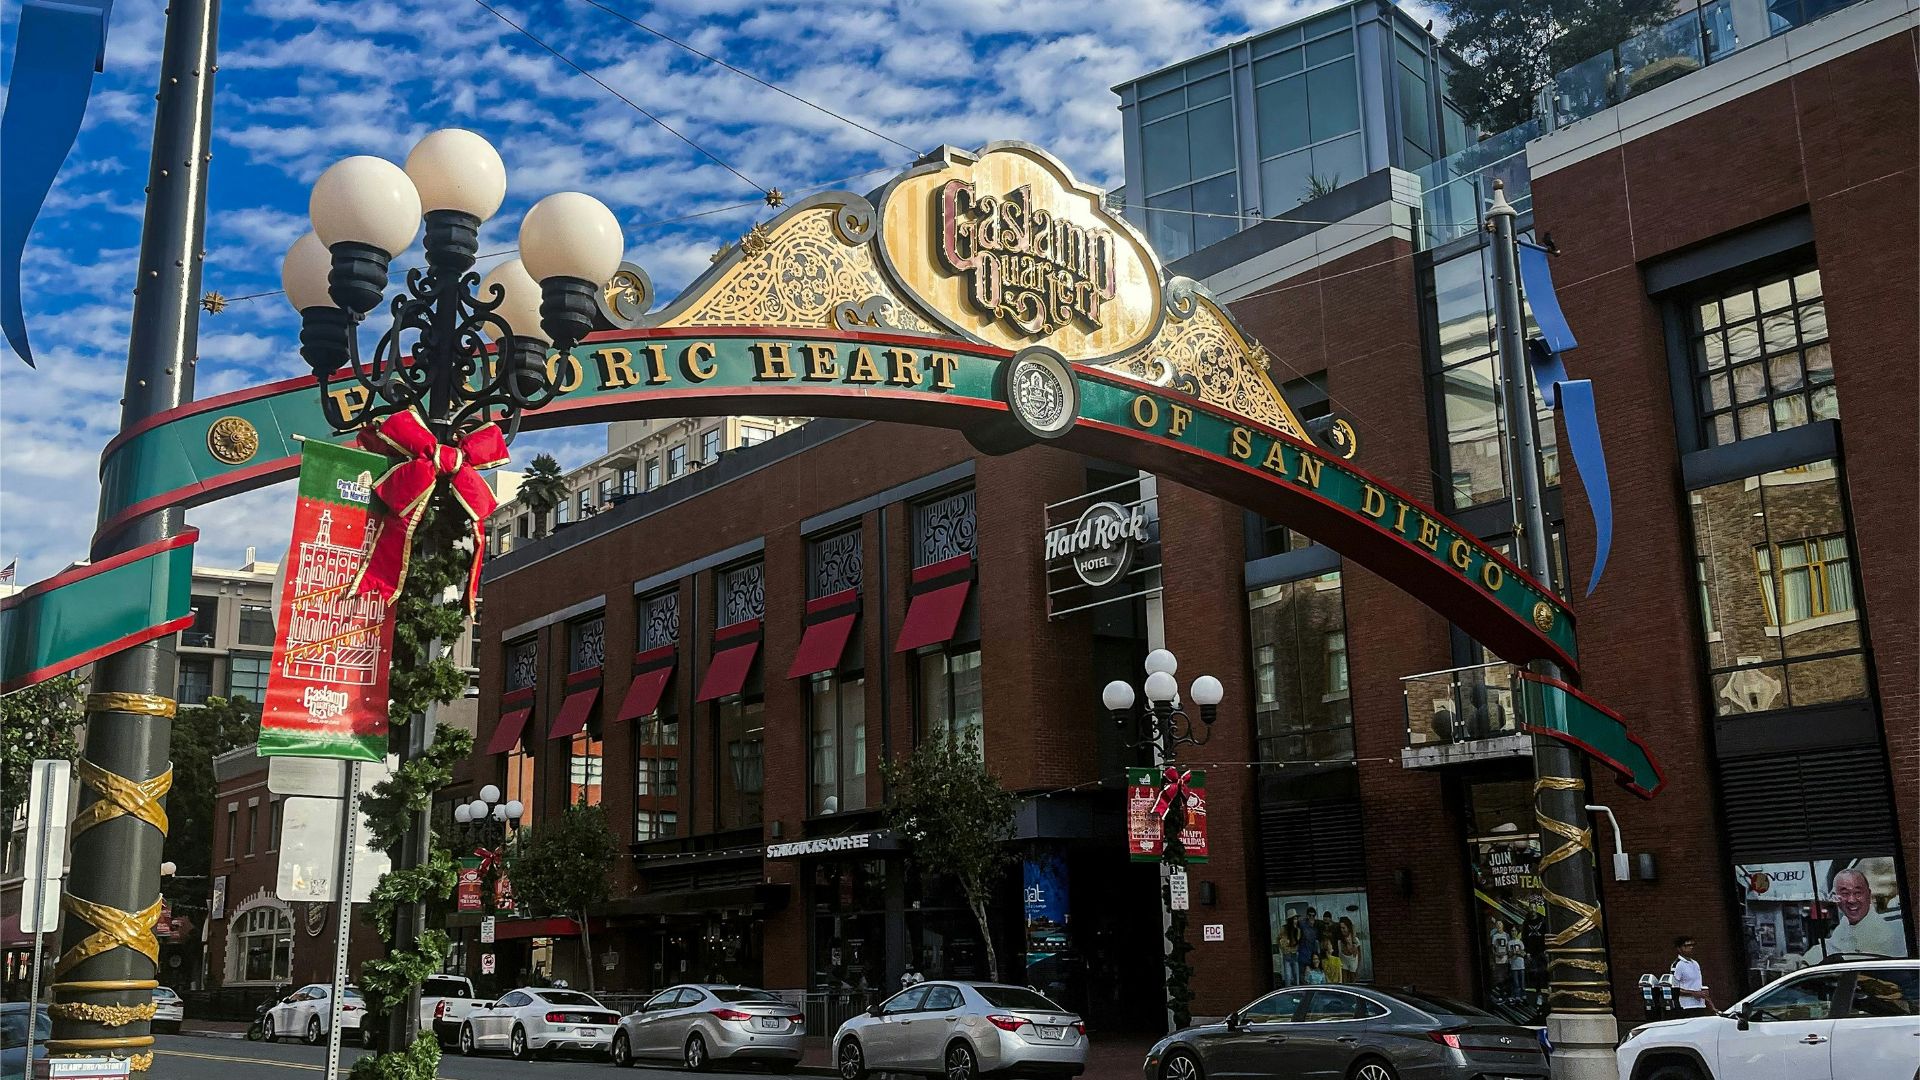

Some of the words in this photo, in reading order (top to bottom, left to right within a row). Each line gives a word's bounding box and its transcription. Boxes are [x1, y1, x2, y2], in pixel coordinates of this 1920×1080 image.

[943, 179, 1116, 326] Gaslamp
[973, 250, 1095, 335] Quarter
[750, 342, 960, 391] HEART
[1132, 394, 1193, 437] OF
[1231, 426, 1325, 489] SAN
[1361, 483, 1504, 591] DIEGO
[1045, 517, 1093, 561] Hard
[1094, 505, 1146, 550] Rock
[1080, 556, 1110, 573] HOTEL
[304, 685, 349, 714] Gaslamp
[766, 838, 826, 859] STARBUCKS
[826, 833, 870, 852] COFFEE
[1489, 851, 1512, 866] JOIN
[1492, 866, 1508, 875] HARD
[1508, 865, 1524, 873] ROCK
[1764, 870, 1805, 882] NOBU
[1205, 926, 1221, 935] FDC
